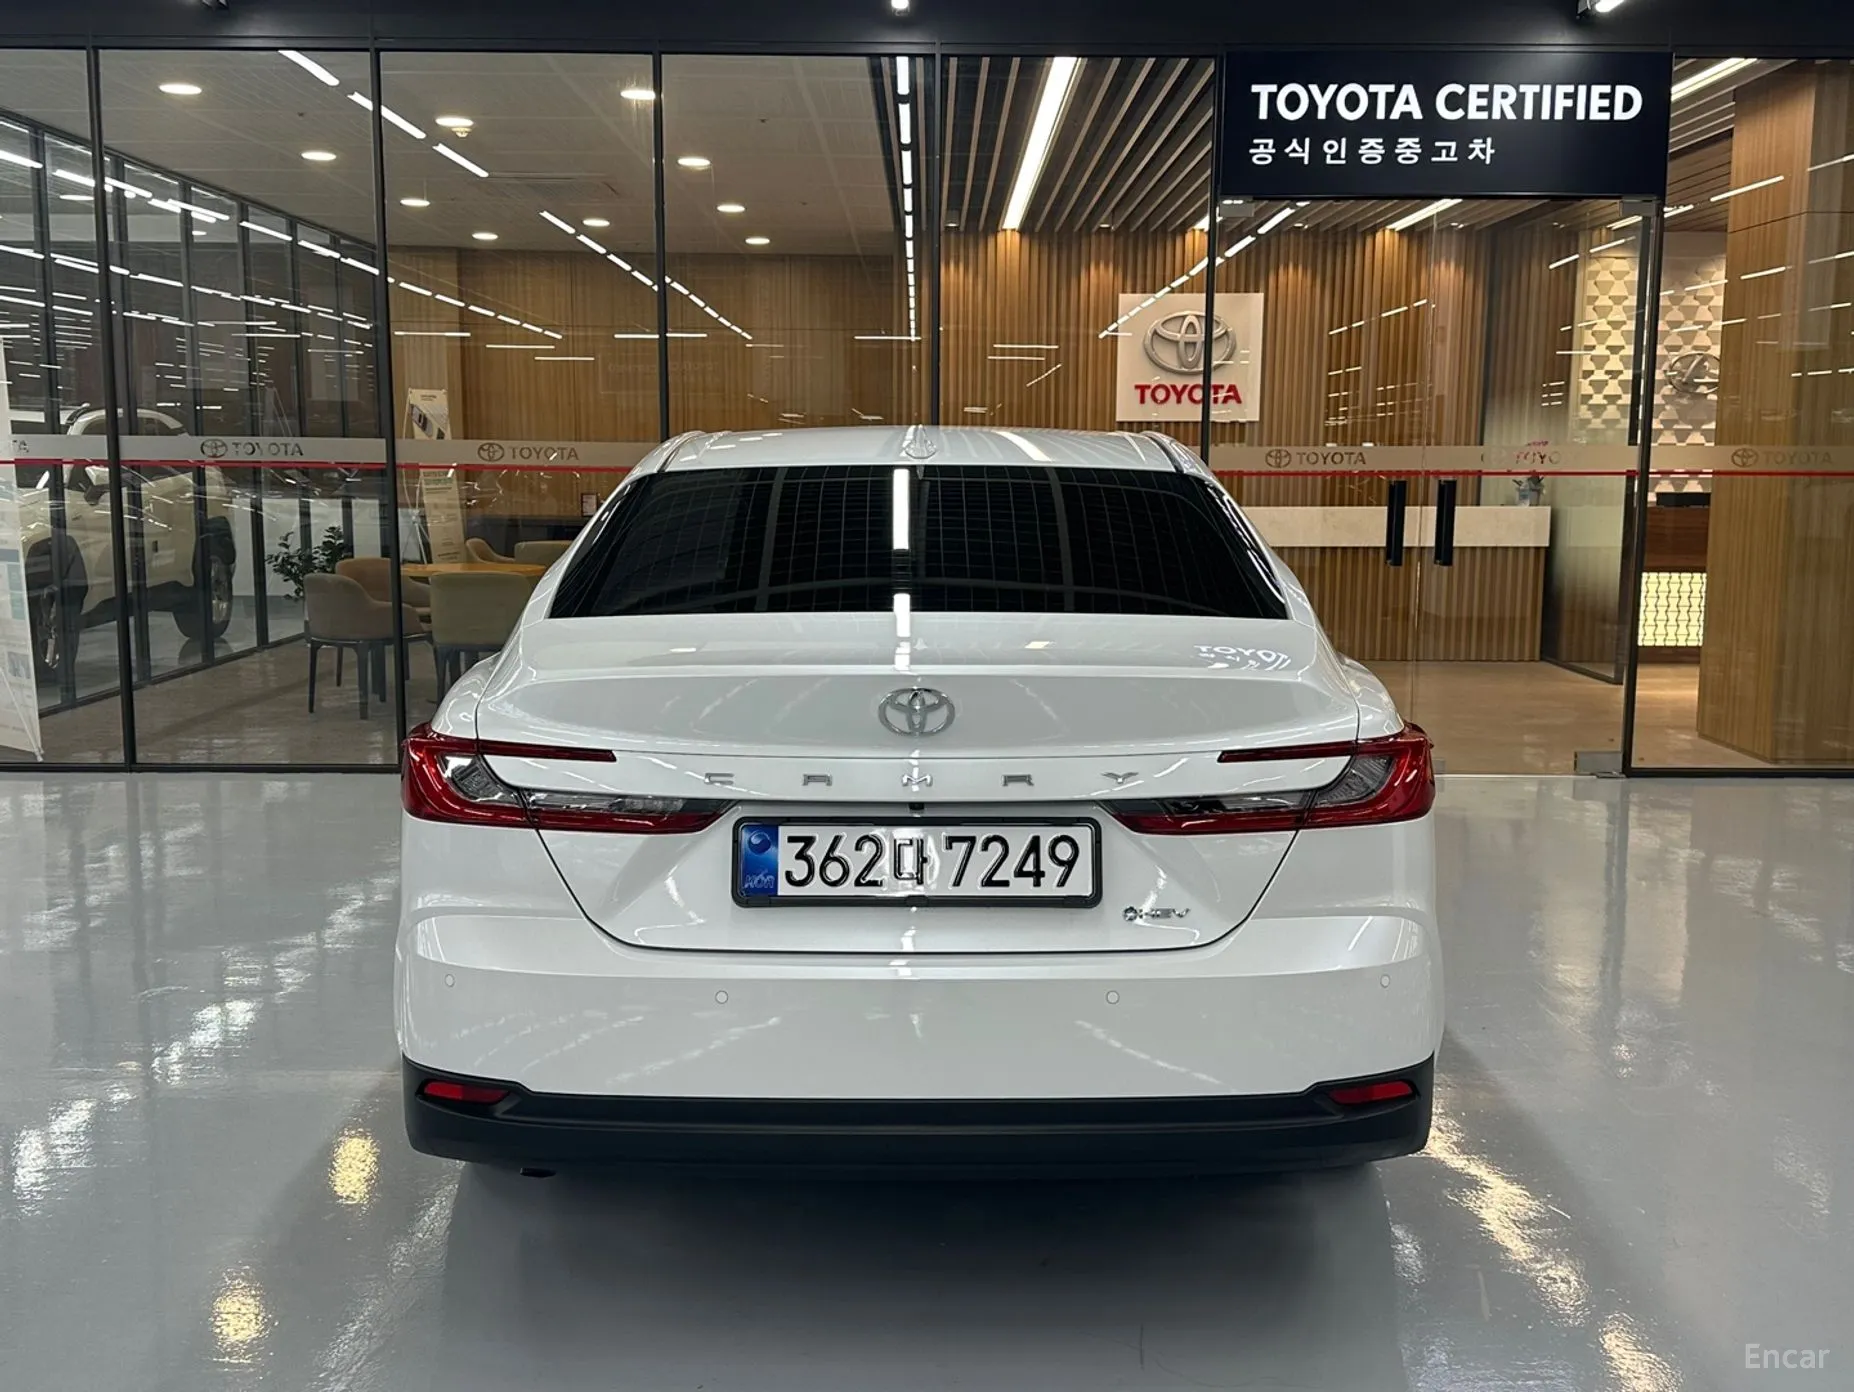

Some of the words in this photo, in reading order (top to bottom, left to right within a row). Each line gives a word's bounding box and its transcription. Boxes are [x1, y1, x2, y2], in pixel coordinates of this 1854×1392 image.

[1251, 83, 1423, 121] TOYOTA
[1435, 83, 1643, 121] CERTIFIED
[1134, 384, 1242, 405] TOYOTA
[510, 446, 579, 460] TOYOTA
[1297, 451, 1367, 465] TOYOTA
[1763, 452, 1833, 465] TOYOTA
[705, 771, 1139, 787] CAMRY
